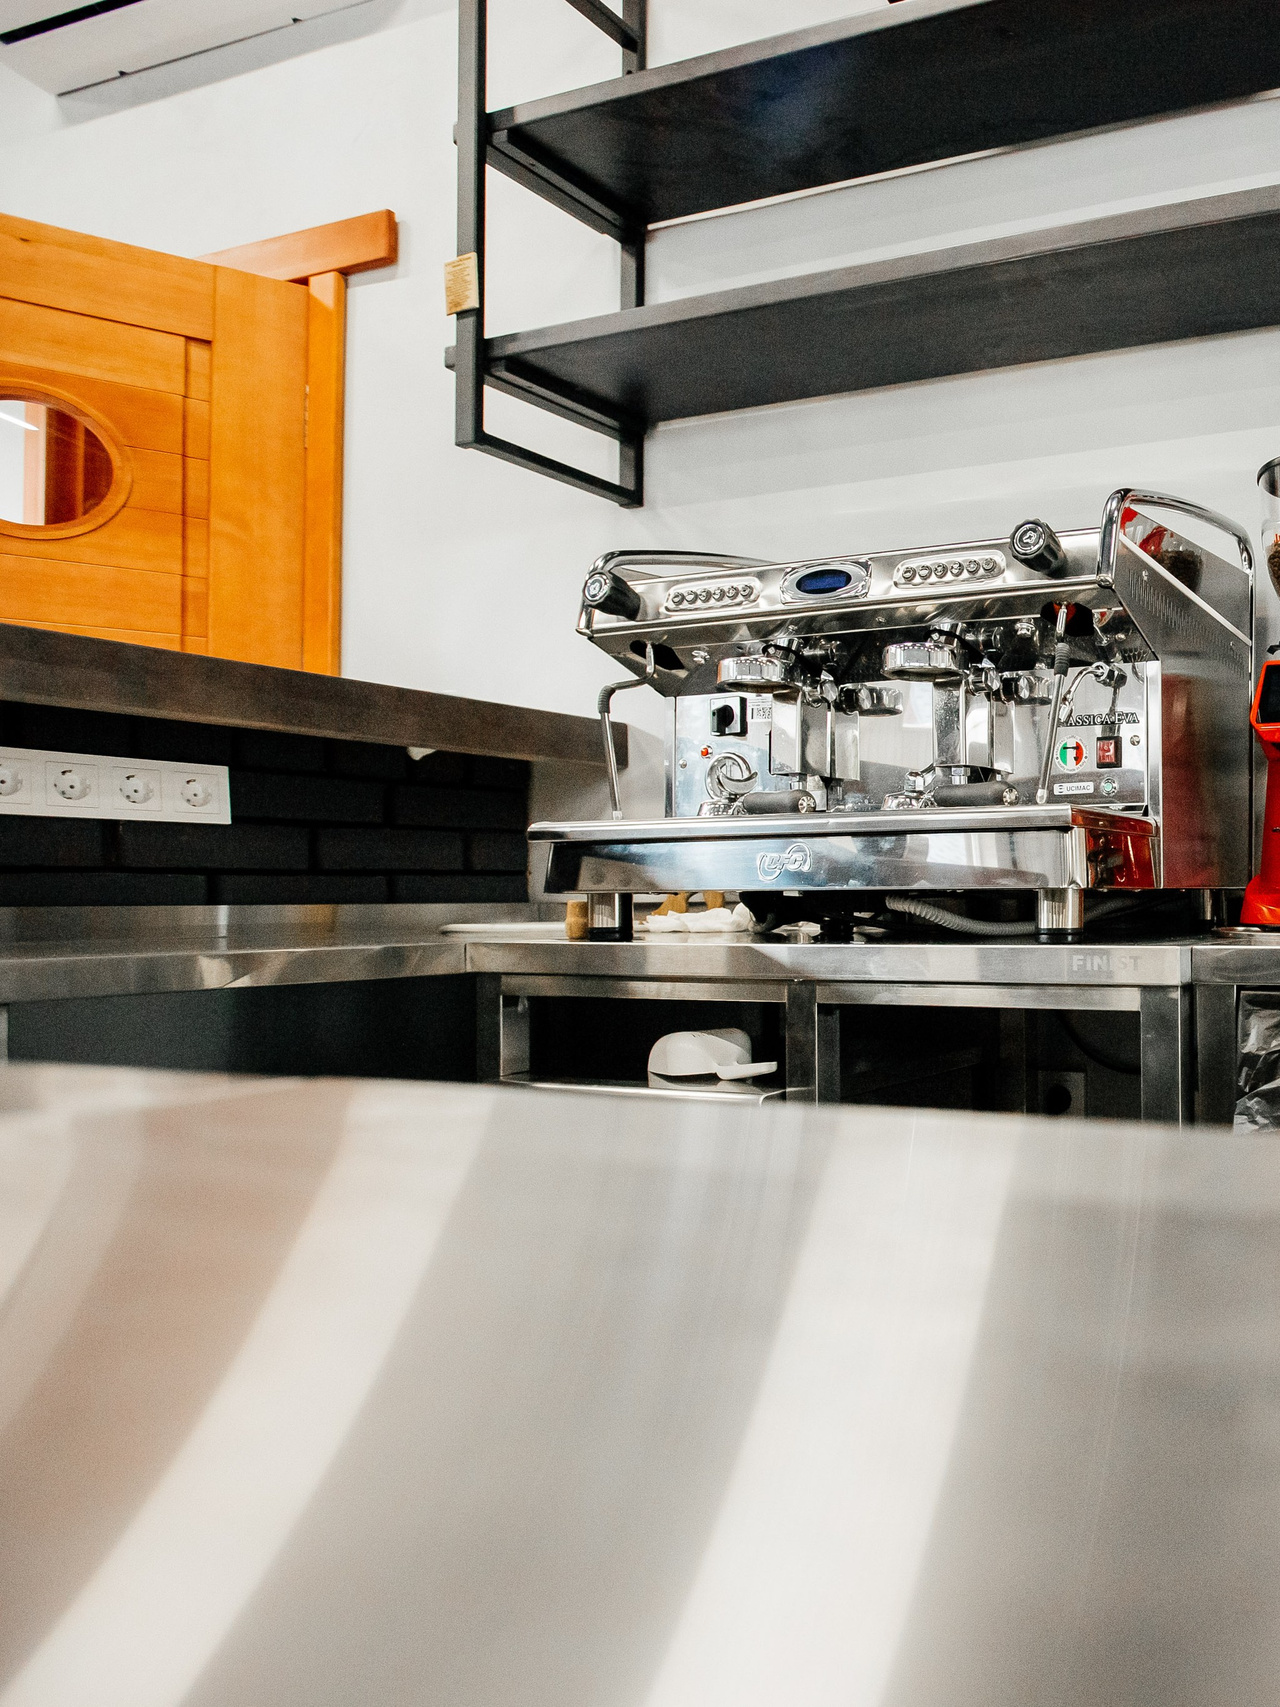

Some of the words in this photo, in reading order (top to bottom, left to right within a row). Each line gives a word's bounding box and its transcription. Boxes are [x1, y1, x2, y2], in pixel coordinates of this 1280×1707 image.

[1048, 711, 1112, 727] ASSICA
[1115, 711, 1139, 725] EVA
[1066, 784, 1091, 792] UCIMAC
